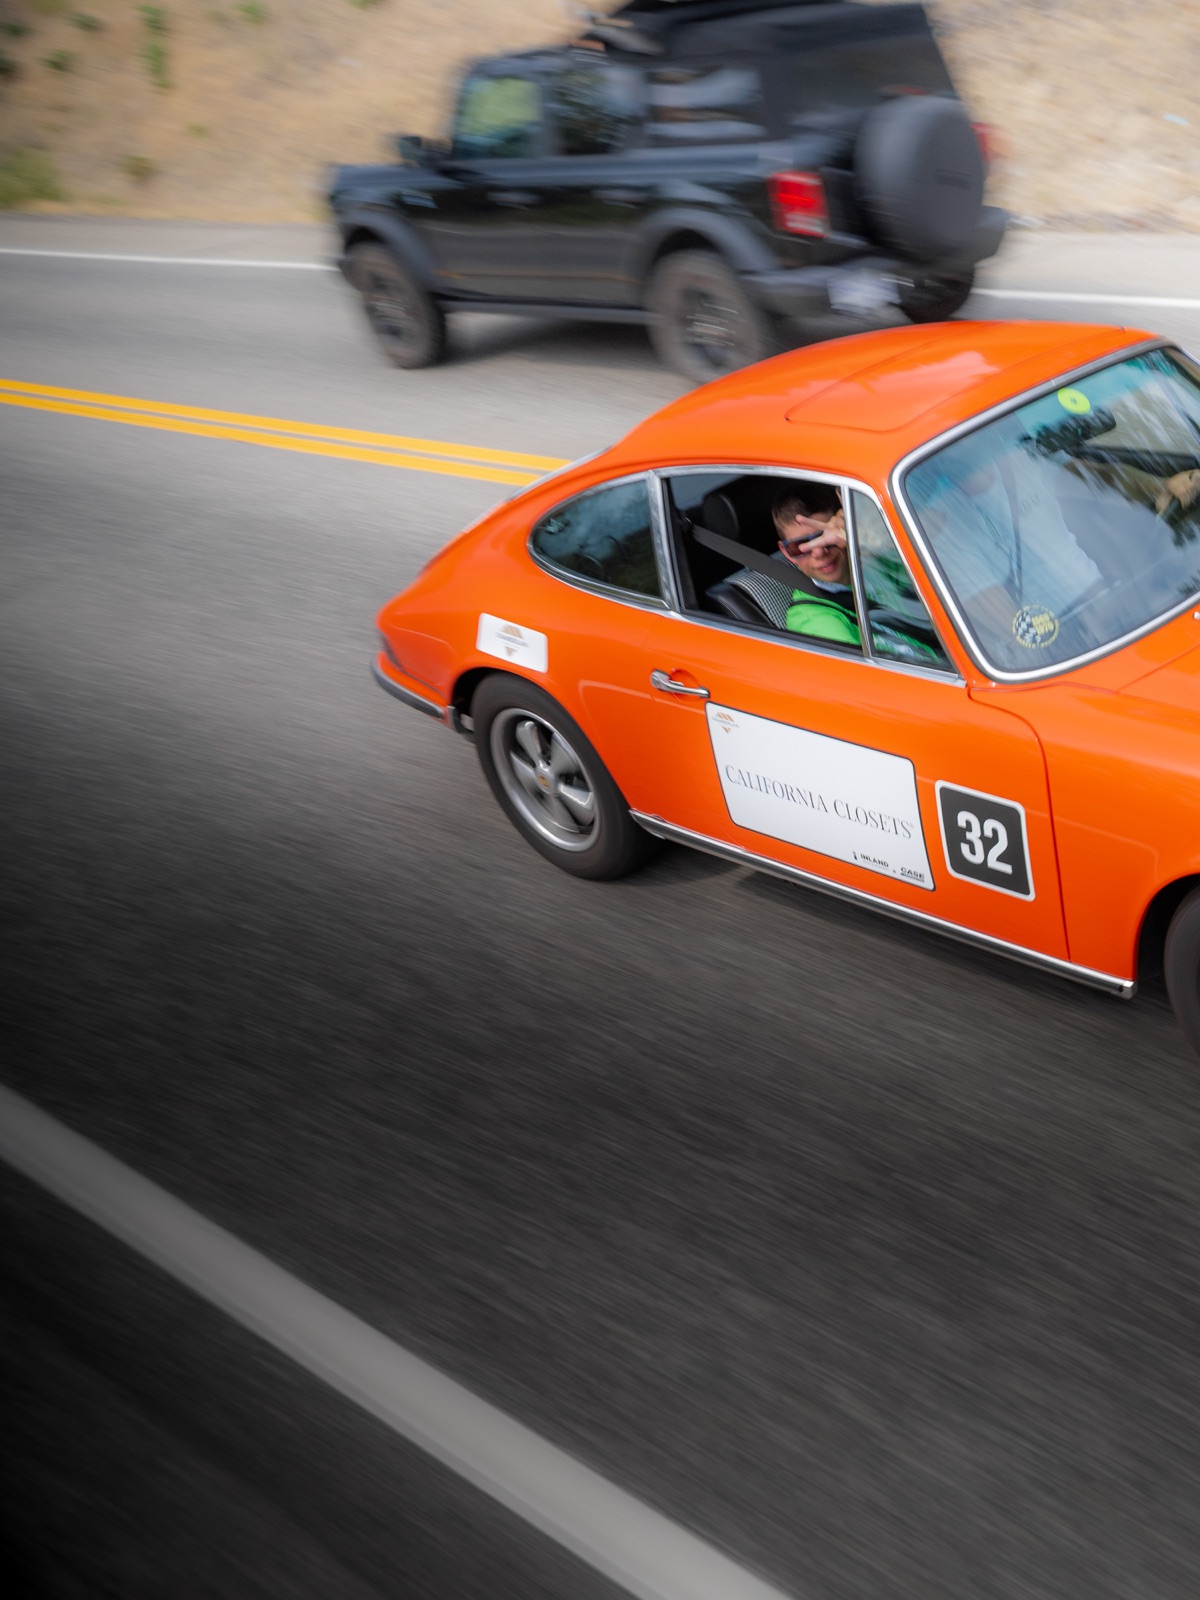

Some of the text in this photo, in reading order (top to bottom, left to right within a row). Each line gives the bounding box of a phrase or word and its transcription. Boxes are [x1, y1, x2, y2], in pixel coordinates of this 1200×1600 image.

[725, 765, 911, 839] CALIFORNIA CLOSETS
[860, 853, 889, 868] INLAND
[900, 866, 925, 879] CASE
[957, 810, 1013, 876] 32
